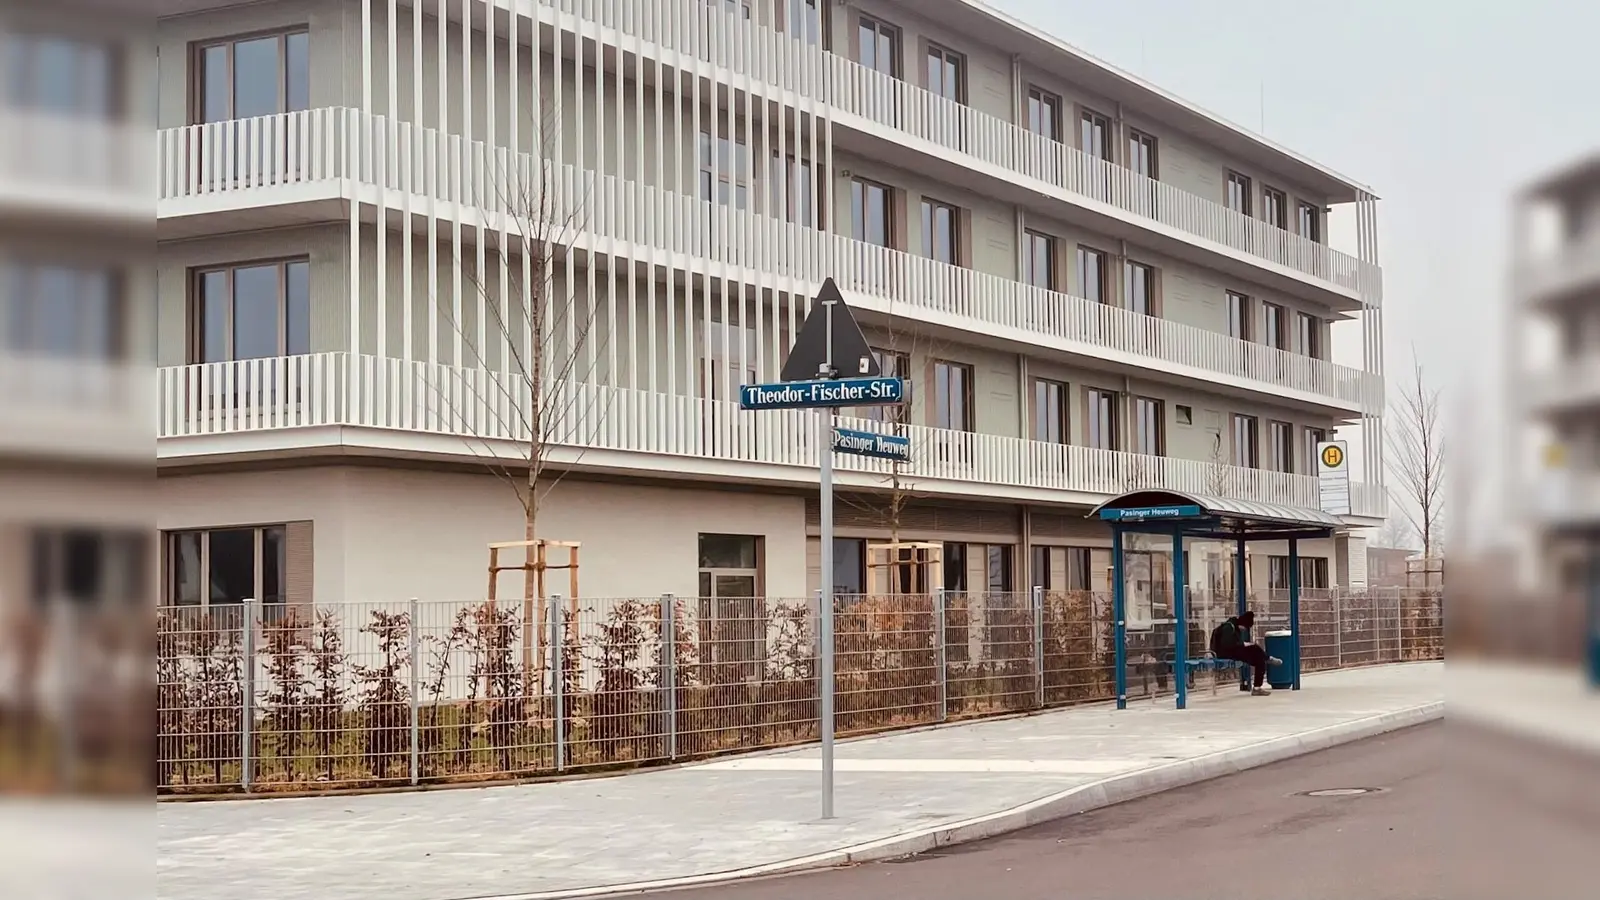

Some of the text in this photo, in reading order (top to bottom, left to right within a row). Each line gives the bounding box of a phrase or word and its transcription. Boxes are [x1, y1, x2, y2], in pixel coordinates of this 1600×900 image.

[747, 381, 896, 404] Theodor-Fischer-Str.
[833, 430, 909, 458] Pasinger Heuweg
[1327, 449, 1338, 463] H
[1120, 508, 1179, 517] Pasinger Heuweg
